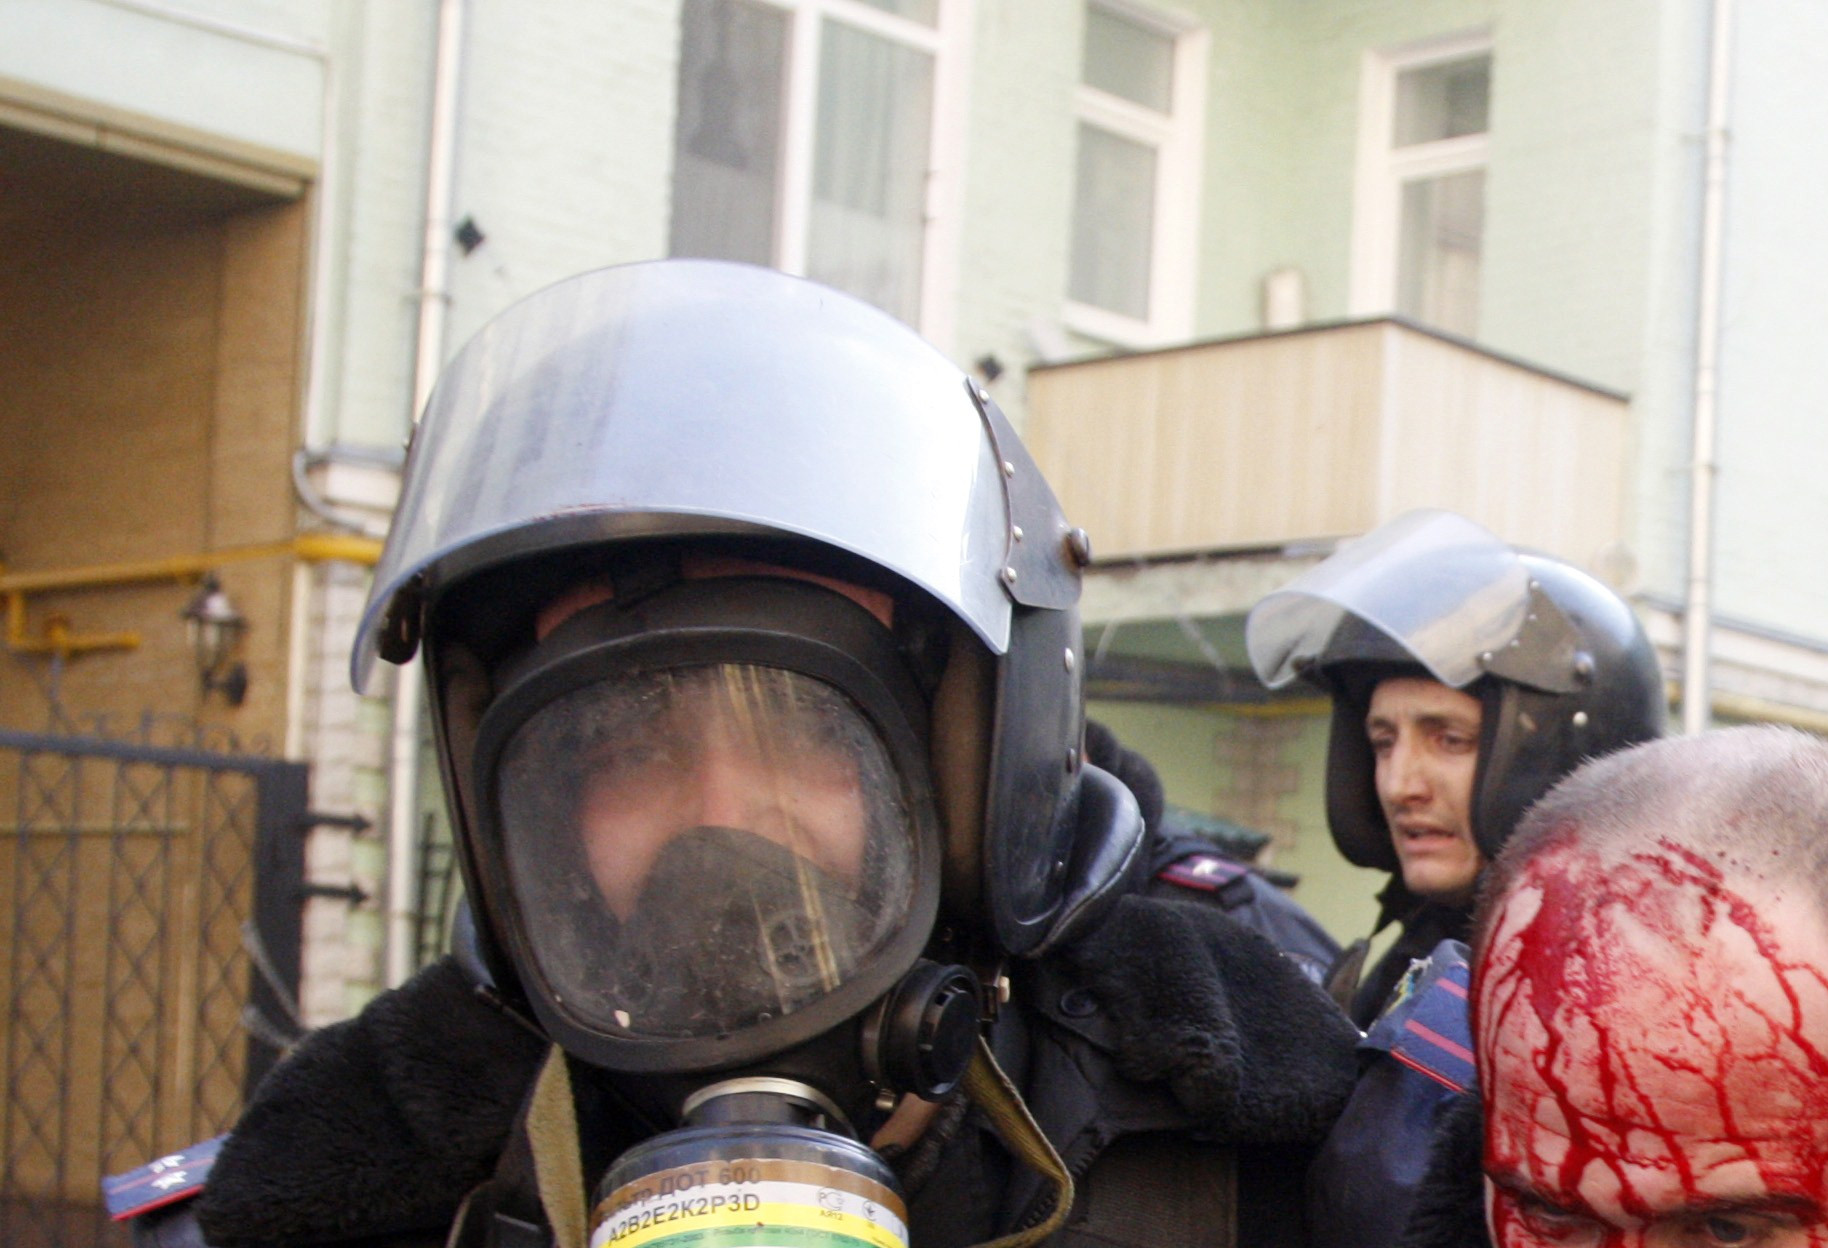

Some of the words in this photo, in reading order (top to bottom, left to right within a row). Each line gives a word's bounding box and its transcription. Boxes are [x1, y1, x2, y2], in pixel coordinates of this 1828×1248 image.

[659, 1171, 709, 1201] ДОТ
[719, 1167, 761, 1187] 600
[608, 1194, 760, 1247] A2B2E2K2P3D
